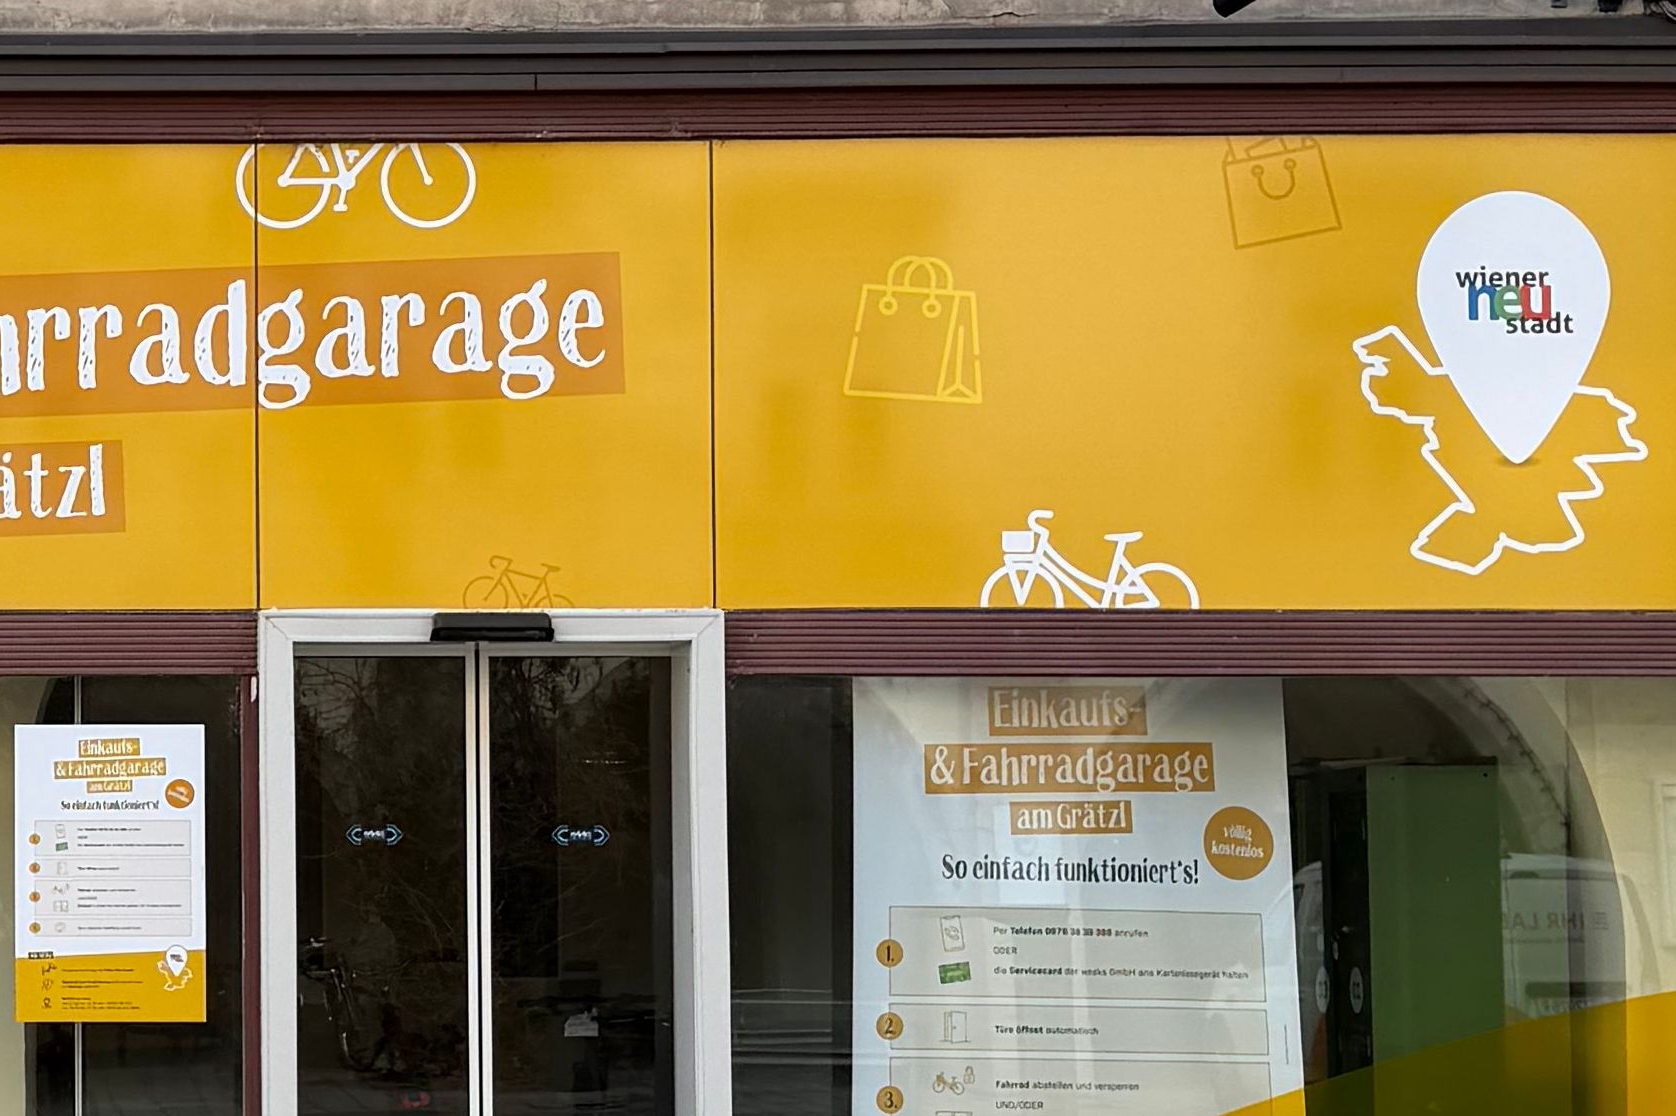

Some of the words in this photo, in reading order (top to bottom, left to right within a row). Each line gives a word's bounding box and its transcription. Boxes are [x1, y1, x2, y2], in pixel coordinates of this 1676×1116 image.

[1455, 265, 1549, 288] wiener
[1468, 284, 1552, 320] neu
[1506, 311, 1574, 334] stadt
[994, 690, 1141, 728] Einkaufs-
[56, 762, 66, 776] &
[68, 760, 163, 777] Fahrradgarage
[930, 746, 955, 786] &
[962, 747, 1210, 791] Fahrradgarage
[1017, 807, 1052, 829] am
[1057, 801, 1127, 828] Grätzl
[1212, 840, 1264, 858] kostenlos
[942, 854, 967, 880] So
[972, 855, 1050, 882] einfach
[886, 945, 895, 962] 1.
[996, 1080, 1030, 1089] Fahrrad
[884, 1091, 898, 1109] 3.
